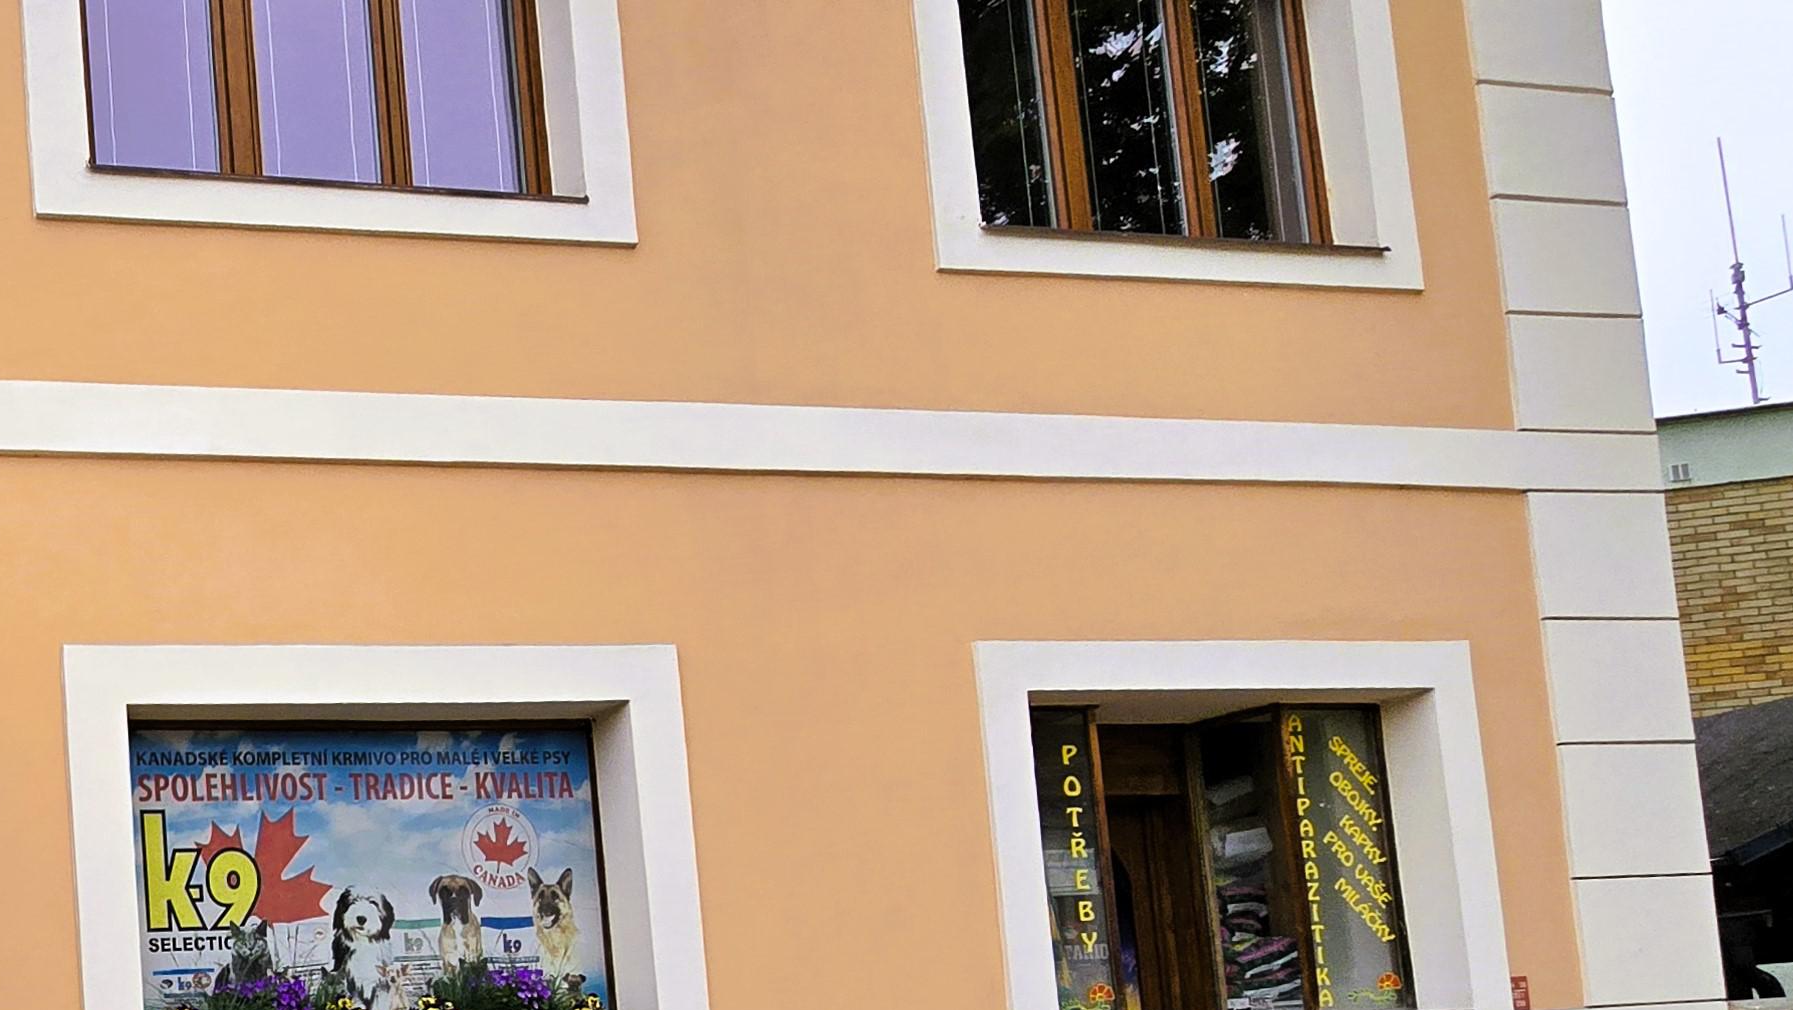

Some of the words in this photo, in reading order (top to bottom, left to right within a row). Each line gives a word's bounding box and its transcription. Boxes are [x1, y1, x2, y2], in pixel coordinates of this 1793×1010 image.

[136, 748, 228, 767] KANADSKÉ
[233, 748, 328, 766] KOMPLETNÍ
[332, 750, 396, 766] KRMIVO
[400, 751, 433, 766] PRO
[437, 748, 480, 766] MALÉ
[484, 751, 489, 765] I
[492, 748, 540, 765] VELKÉ
[543, 751, 571, 765] PSY
[138, 772, 327, 802] SPOLEHLIVOST
[348, 772, 454, 801] TRADICE
[475, 771, 575, 800] KVALITA
[1061, 744, 1098, 954] POTŘEBY
[1323, 830, 1354, 867] PRO
[1339, 814, 1388, 865] KAPKY
[473, 864, 526, 888] CANADA
[1287, 713, 1334, 1008] ANTIPARAZITIKA
